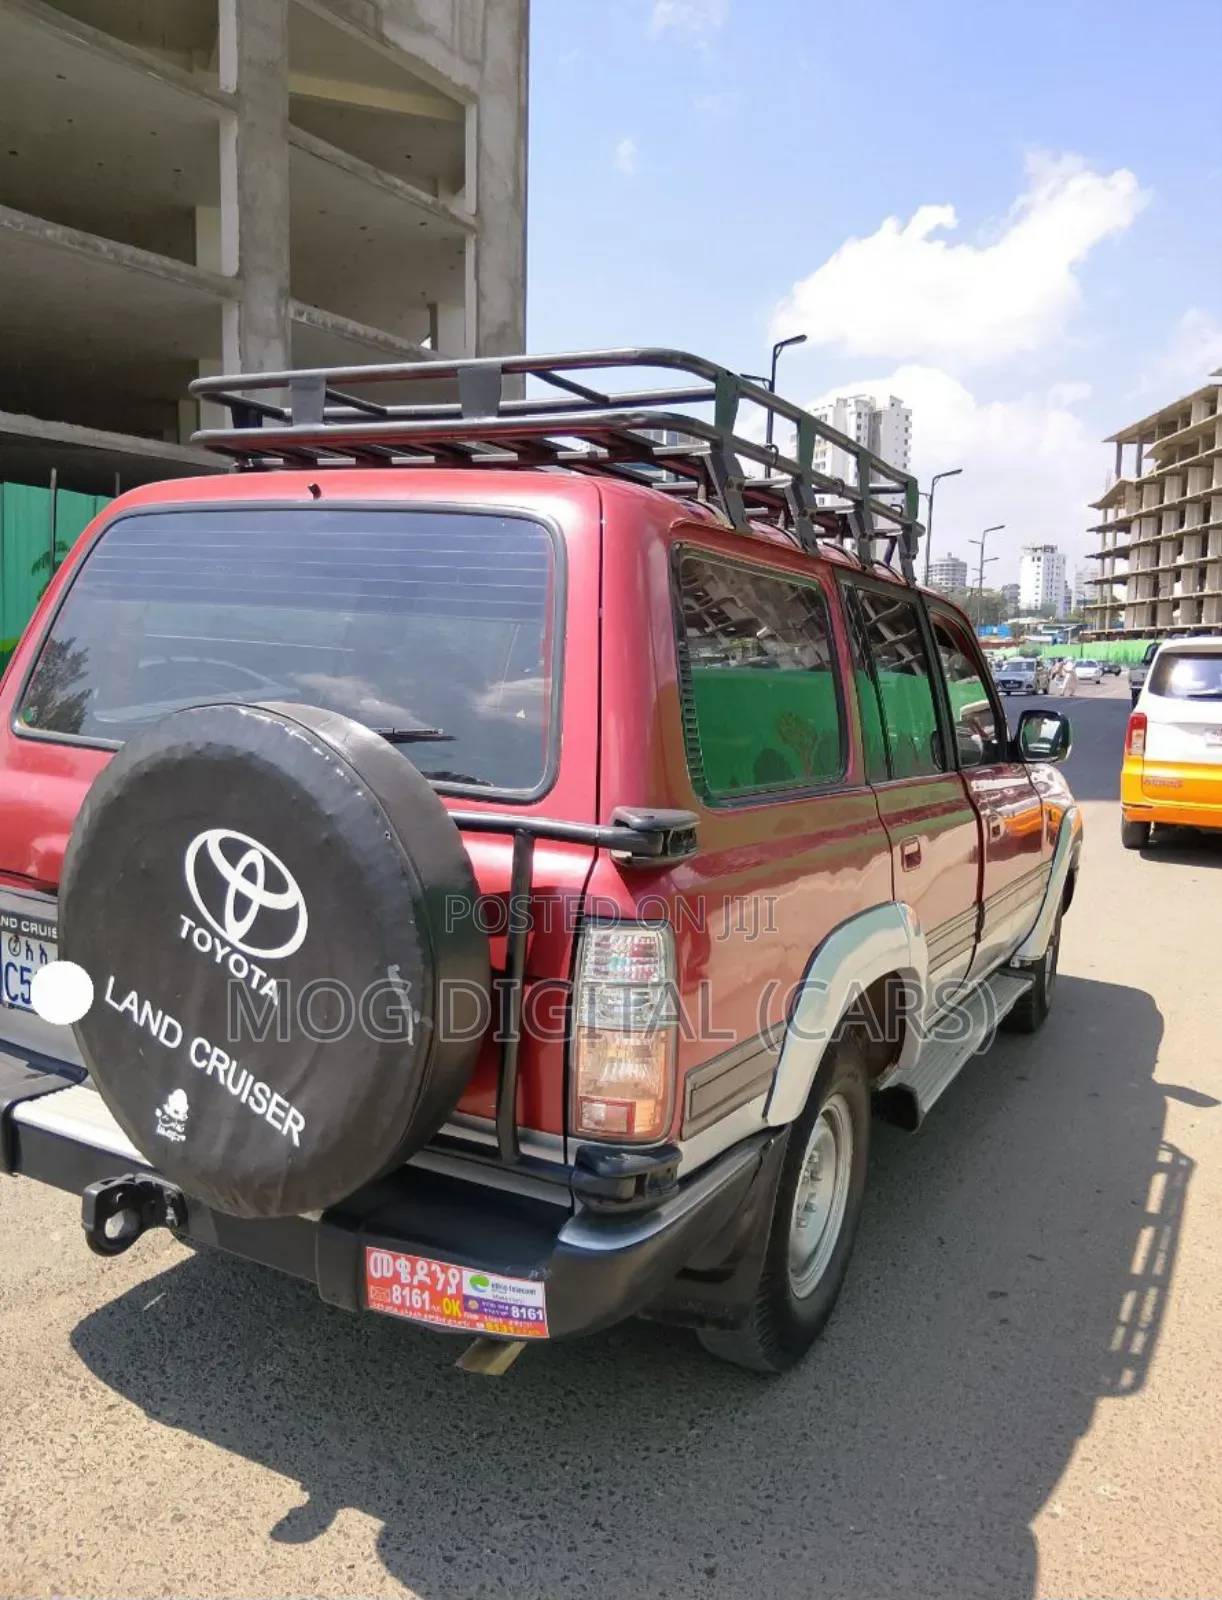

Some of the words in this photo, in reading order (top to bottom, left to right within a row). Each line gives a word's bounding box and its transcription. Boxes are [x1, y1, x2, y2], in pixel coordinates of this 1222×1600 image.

[180, 914, 278, 1006] TOYOTA
[4, 962, 36, 1005] C5
[105, 975, 183, 1049] LAND
[190, 1037, 305, 1147] CRUISER
[392, 1285, 430, 1311] 8161
[442, 1298, 462, 1318] OK
[511, 1306, 544, 1321] 8161
